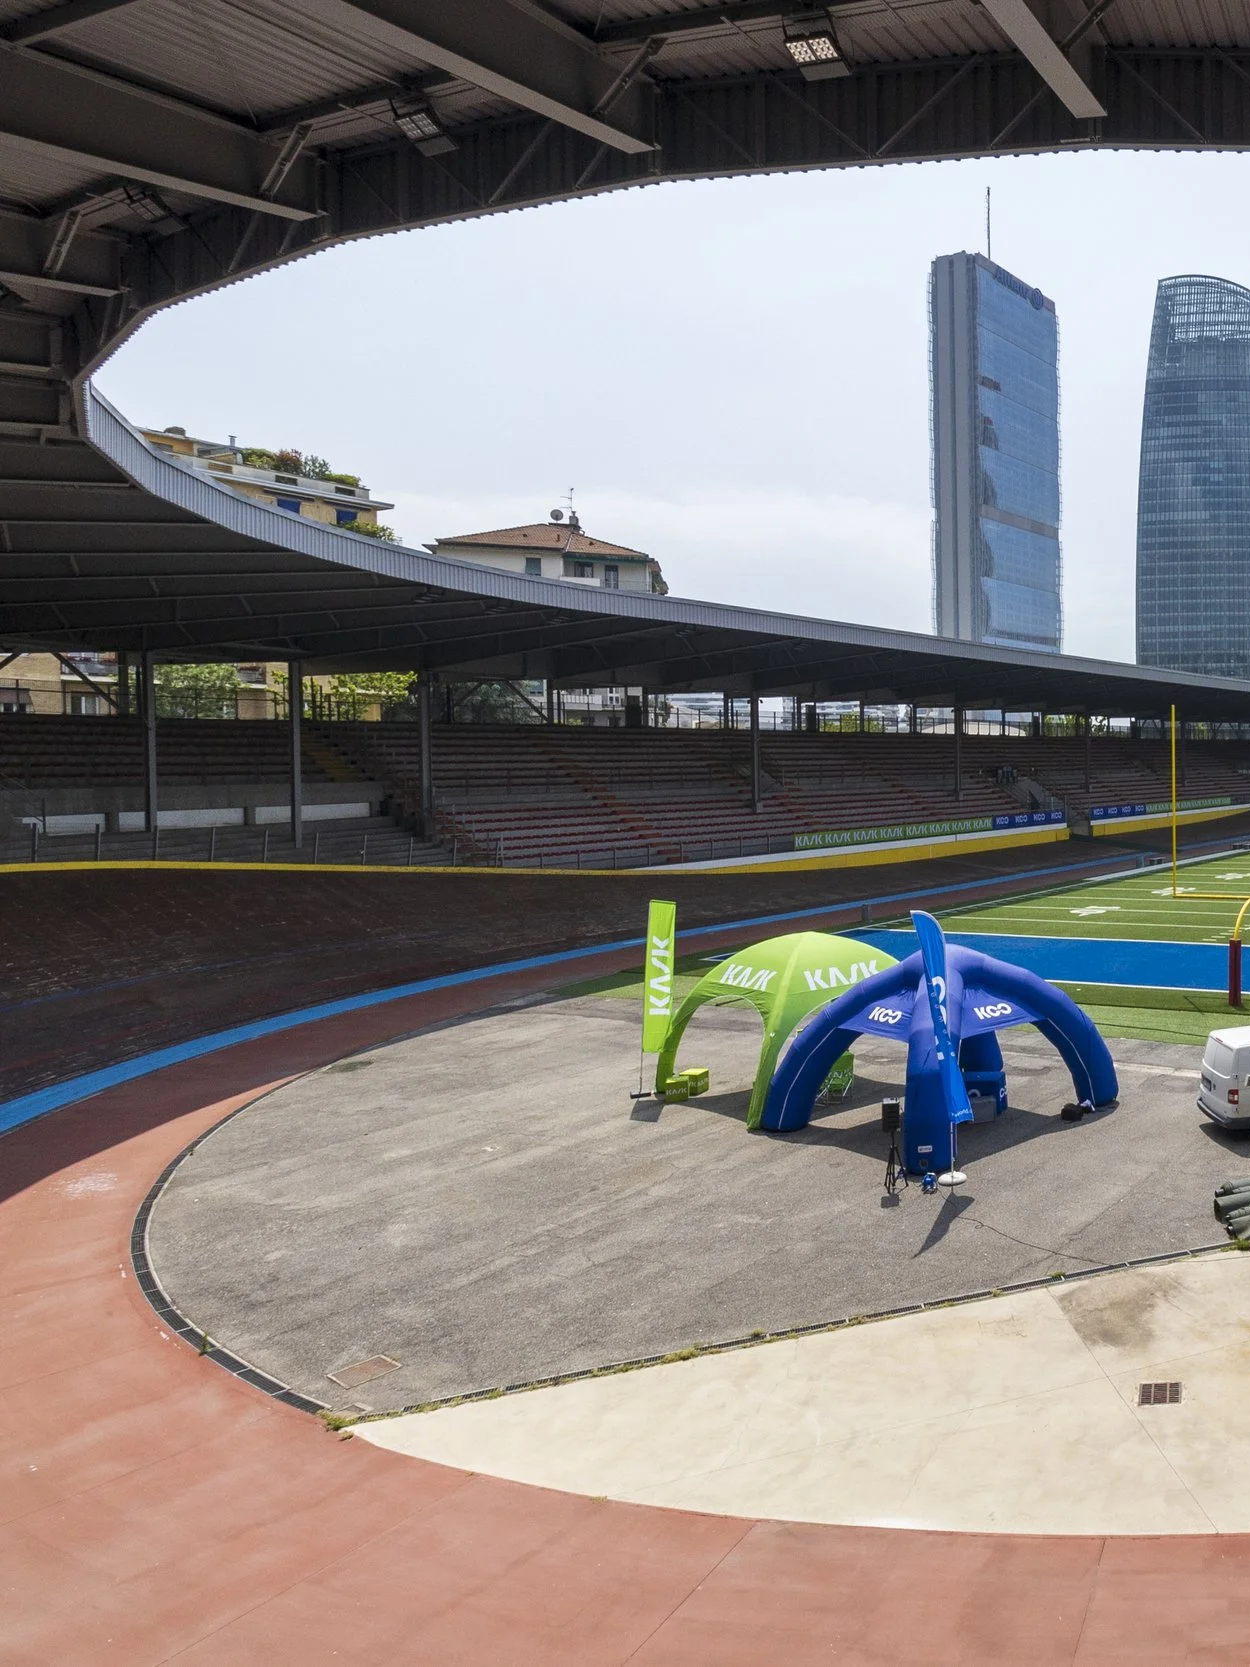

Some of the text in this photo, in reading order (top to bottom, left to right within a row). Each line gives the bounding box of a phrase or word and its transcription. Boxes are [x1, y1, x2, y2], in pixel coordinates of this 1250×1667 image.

[649, 935, 670, 1015] KASK
[720, 963, 777, 991] KASK
[803, 959, 880, 991] KASK
